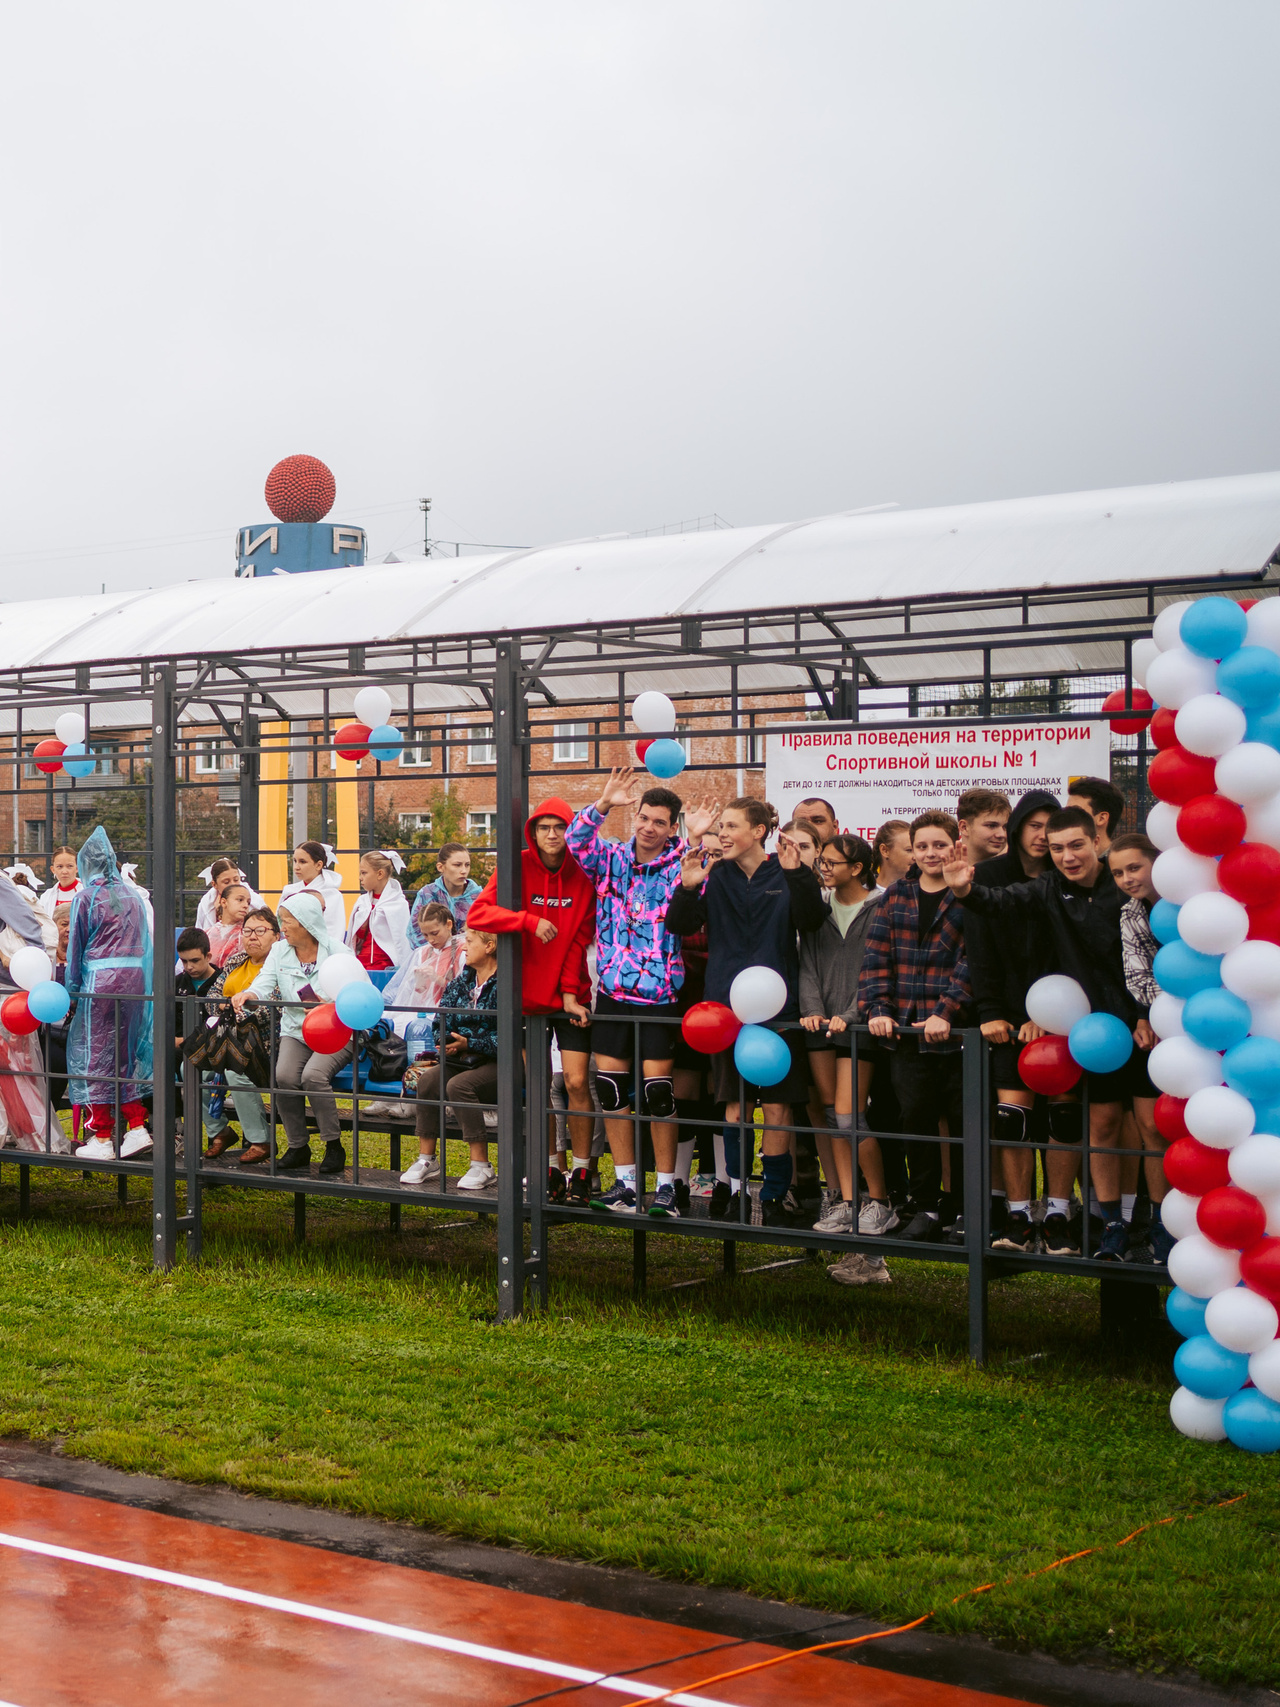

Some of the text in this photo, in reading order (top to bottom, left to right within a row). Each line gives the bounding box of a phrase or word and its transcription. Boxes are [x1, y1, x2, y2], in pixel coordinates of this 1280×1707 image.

[782, 726, 1091, 750] Правила поведения на территории
[826, 750, 1037, 774] Спортивной школы № 1
[783, 777, 1062, 789] ДЕТИ ДО 12 ЛЕТ ДОЛЖНЫ НАХОДИТЬСЯ НА ДЕТСКИХ ИГРОВЫХ ПЛОЩАДКАХ
[912, 788, 943, 797] ТОЛЬКО
[944, 788, 960, 798] ПОД
[881, 807, 892, 815] НА
